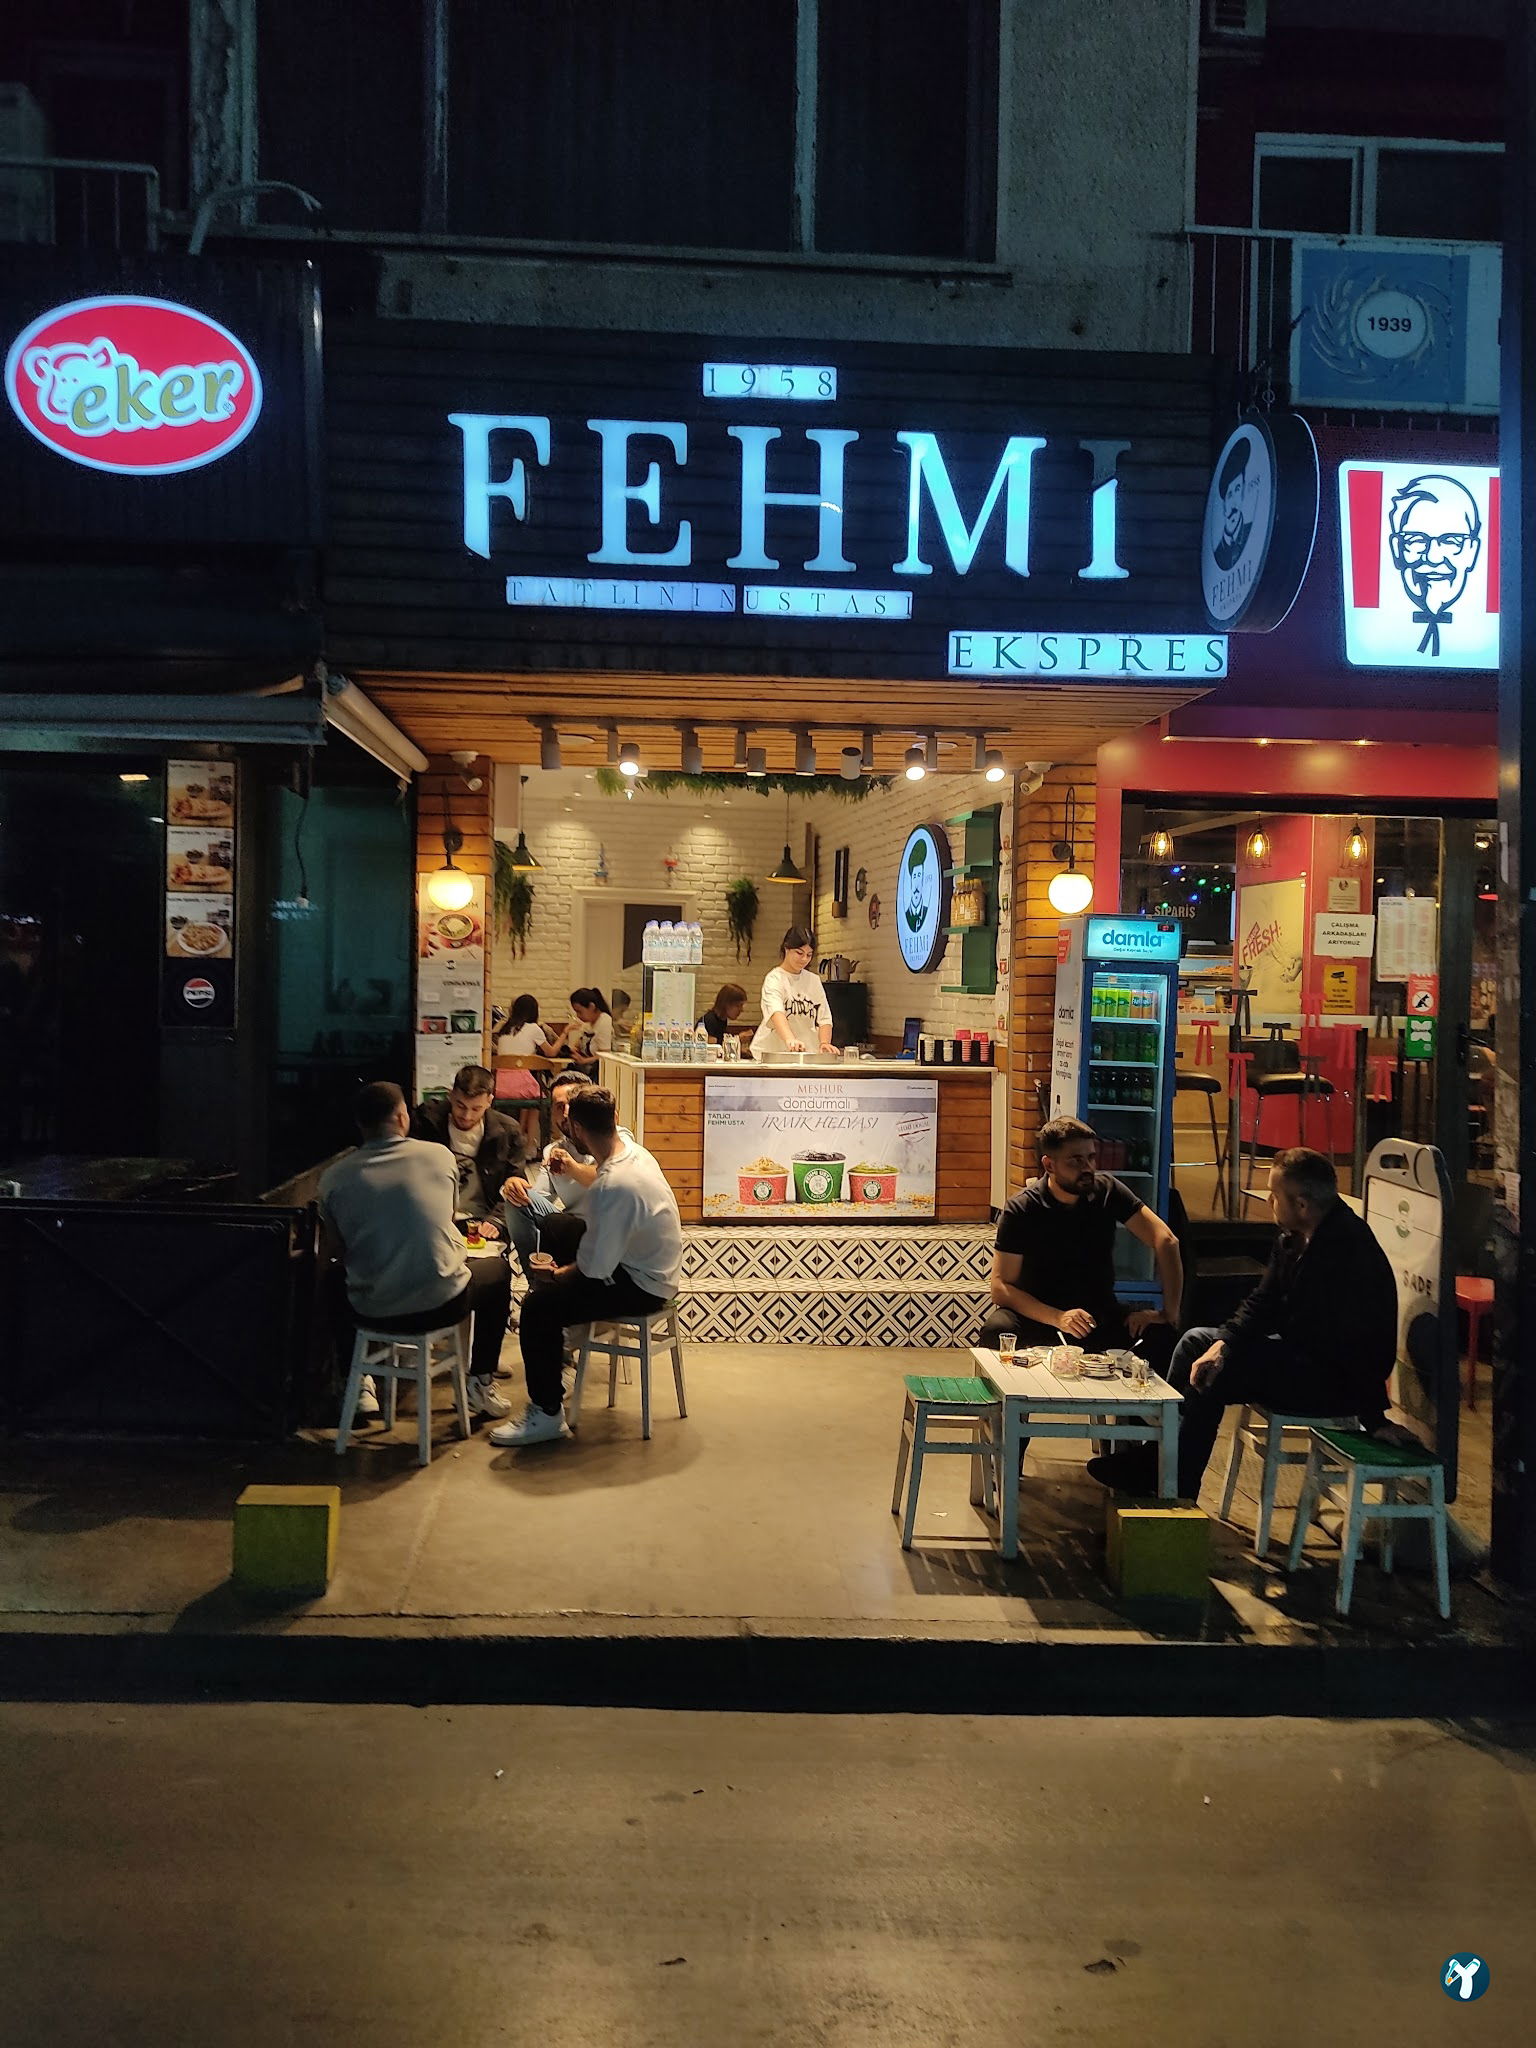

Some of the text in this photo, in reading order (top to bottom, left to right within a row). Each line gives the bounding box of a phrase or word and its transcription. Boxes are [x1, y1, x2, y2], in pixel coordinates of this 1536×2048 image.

[1367, 316, 1412, 333] 1939
[708, 367, 833, 397] 1958
[72, 363, 235, 430] eker
[511, 581, 913, 616] TATLININ USTASI
[951, 635, 1226, 673] EKSPRES
[1102, 929, 1162, 947] damla
[783, 1097, 851, 1110] dondurmalı
[815, 1115, 880, 1130] HELVASI
[1402, 1269, 1433, 1296] SADE
